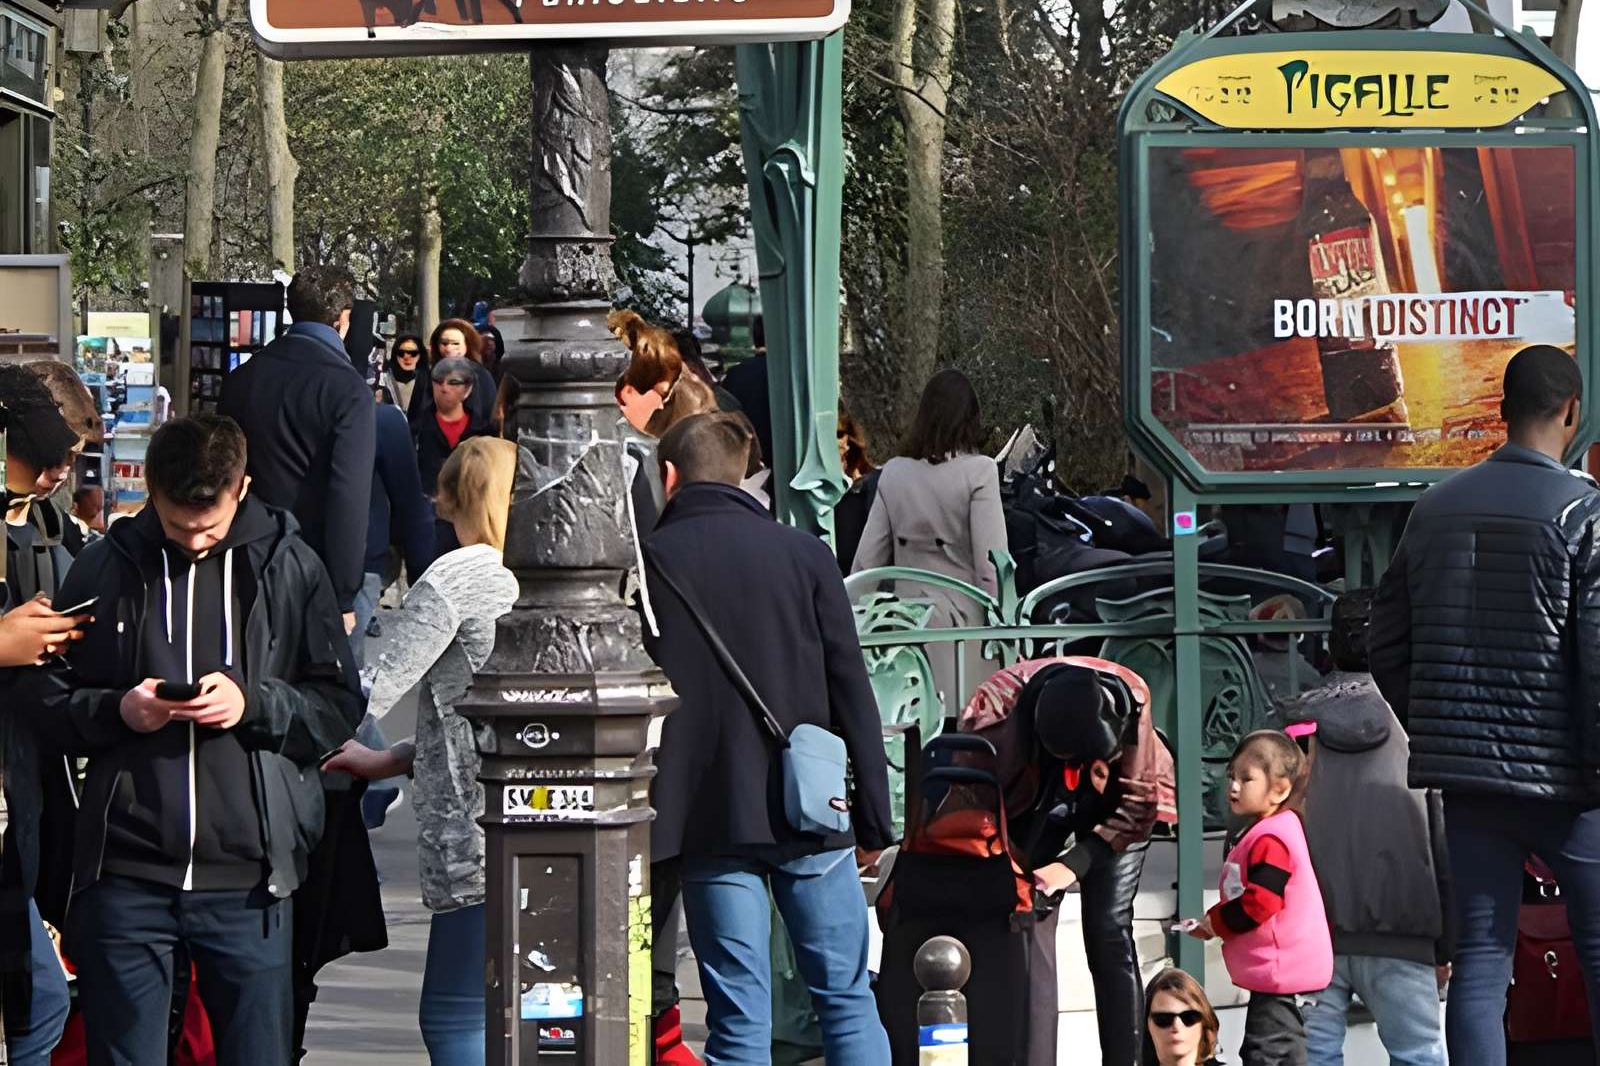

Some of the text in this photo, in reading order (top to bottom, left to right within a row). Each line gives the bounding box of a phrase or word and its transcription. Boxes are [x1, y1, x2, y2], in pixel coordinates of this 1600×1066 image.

[1278, 60, 1449, 116] PIGALLE
[1274, 297, 1520, 338] BORN DISTINCT
